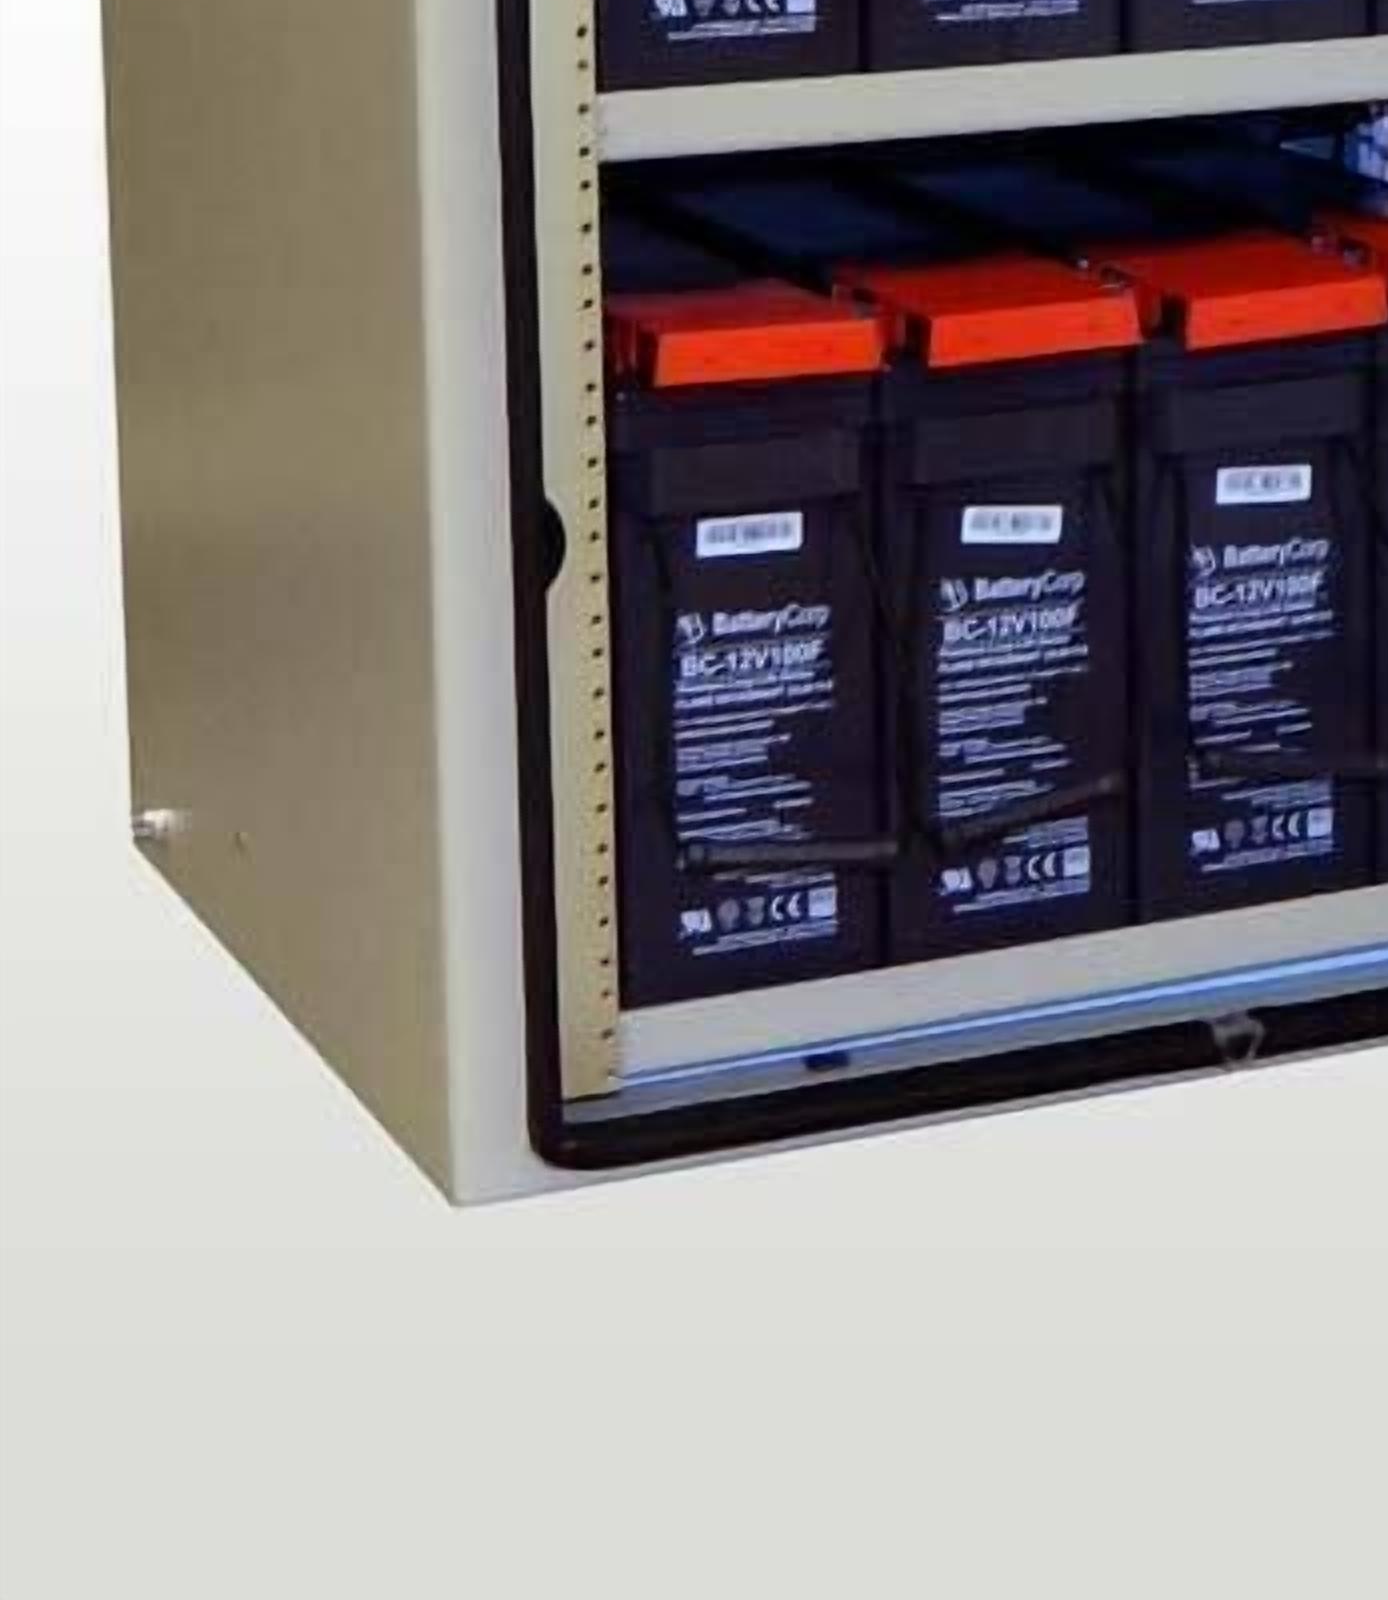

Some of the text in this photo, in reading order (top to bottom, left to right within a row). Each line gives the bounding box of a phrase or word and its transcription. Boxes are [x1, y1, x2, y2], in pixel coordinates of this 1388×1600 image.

[1223, 537, 1328, 568] BatteryCorp
[974, 569, 1084, 601] BatteryCorp
[712, 603, 831, 635] BatteryCorp
